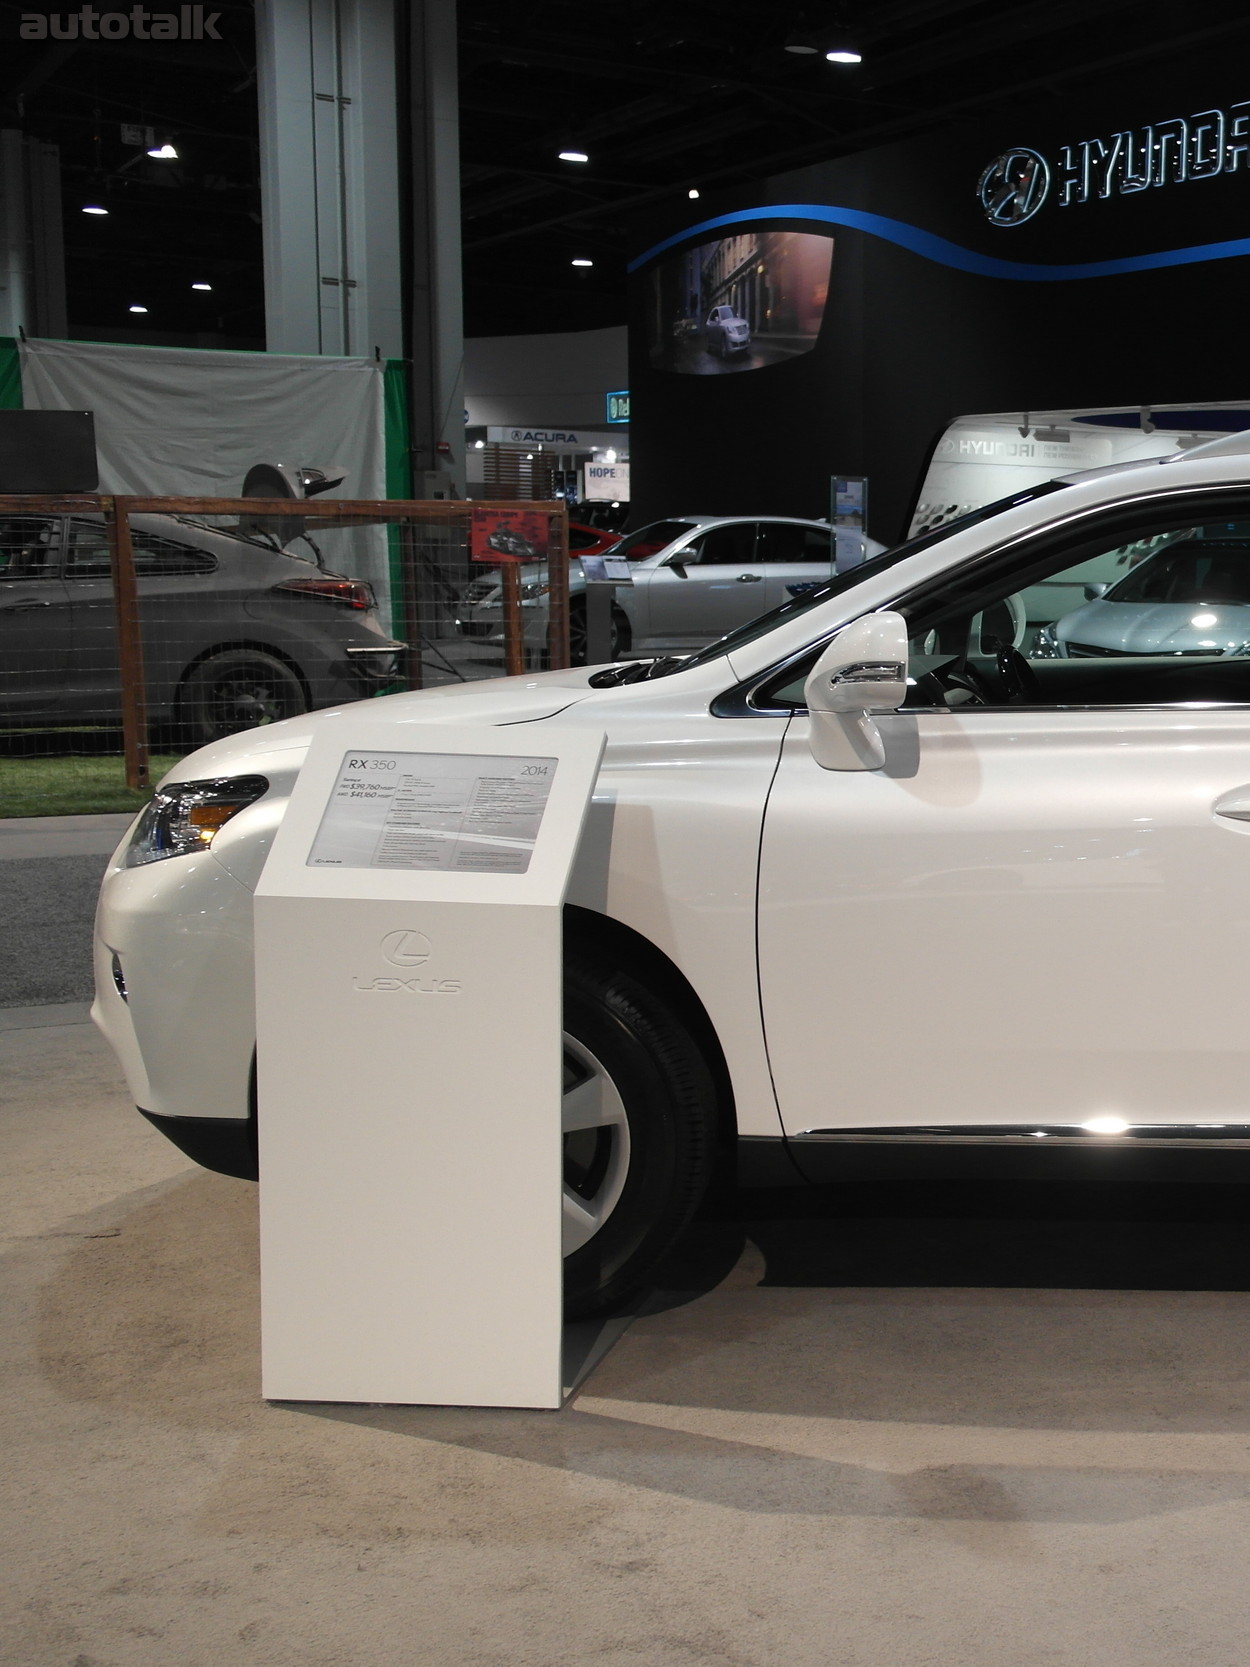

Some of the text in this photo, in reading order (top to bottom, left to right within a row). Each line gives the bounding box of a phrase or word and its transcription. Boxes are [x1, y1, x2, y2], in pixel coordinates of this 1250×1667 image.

[523, 431, 578, 444] ACURA
[959, 440, 1035, 457] HYUNDAI
[348, 759, 397, 771] RX 350
[520, 765, 549, 776] 2014
[350, 783, 381, 791] $39,760
[352, 976, 463, 995] LEXUS
